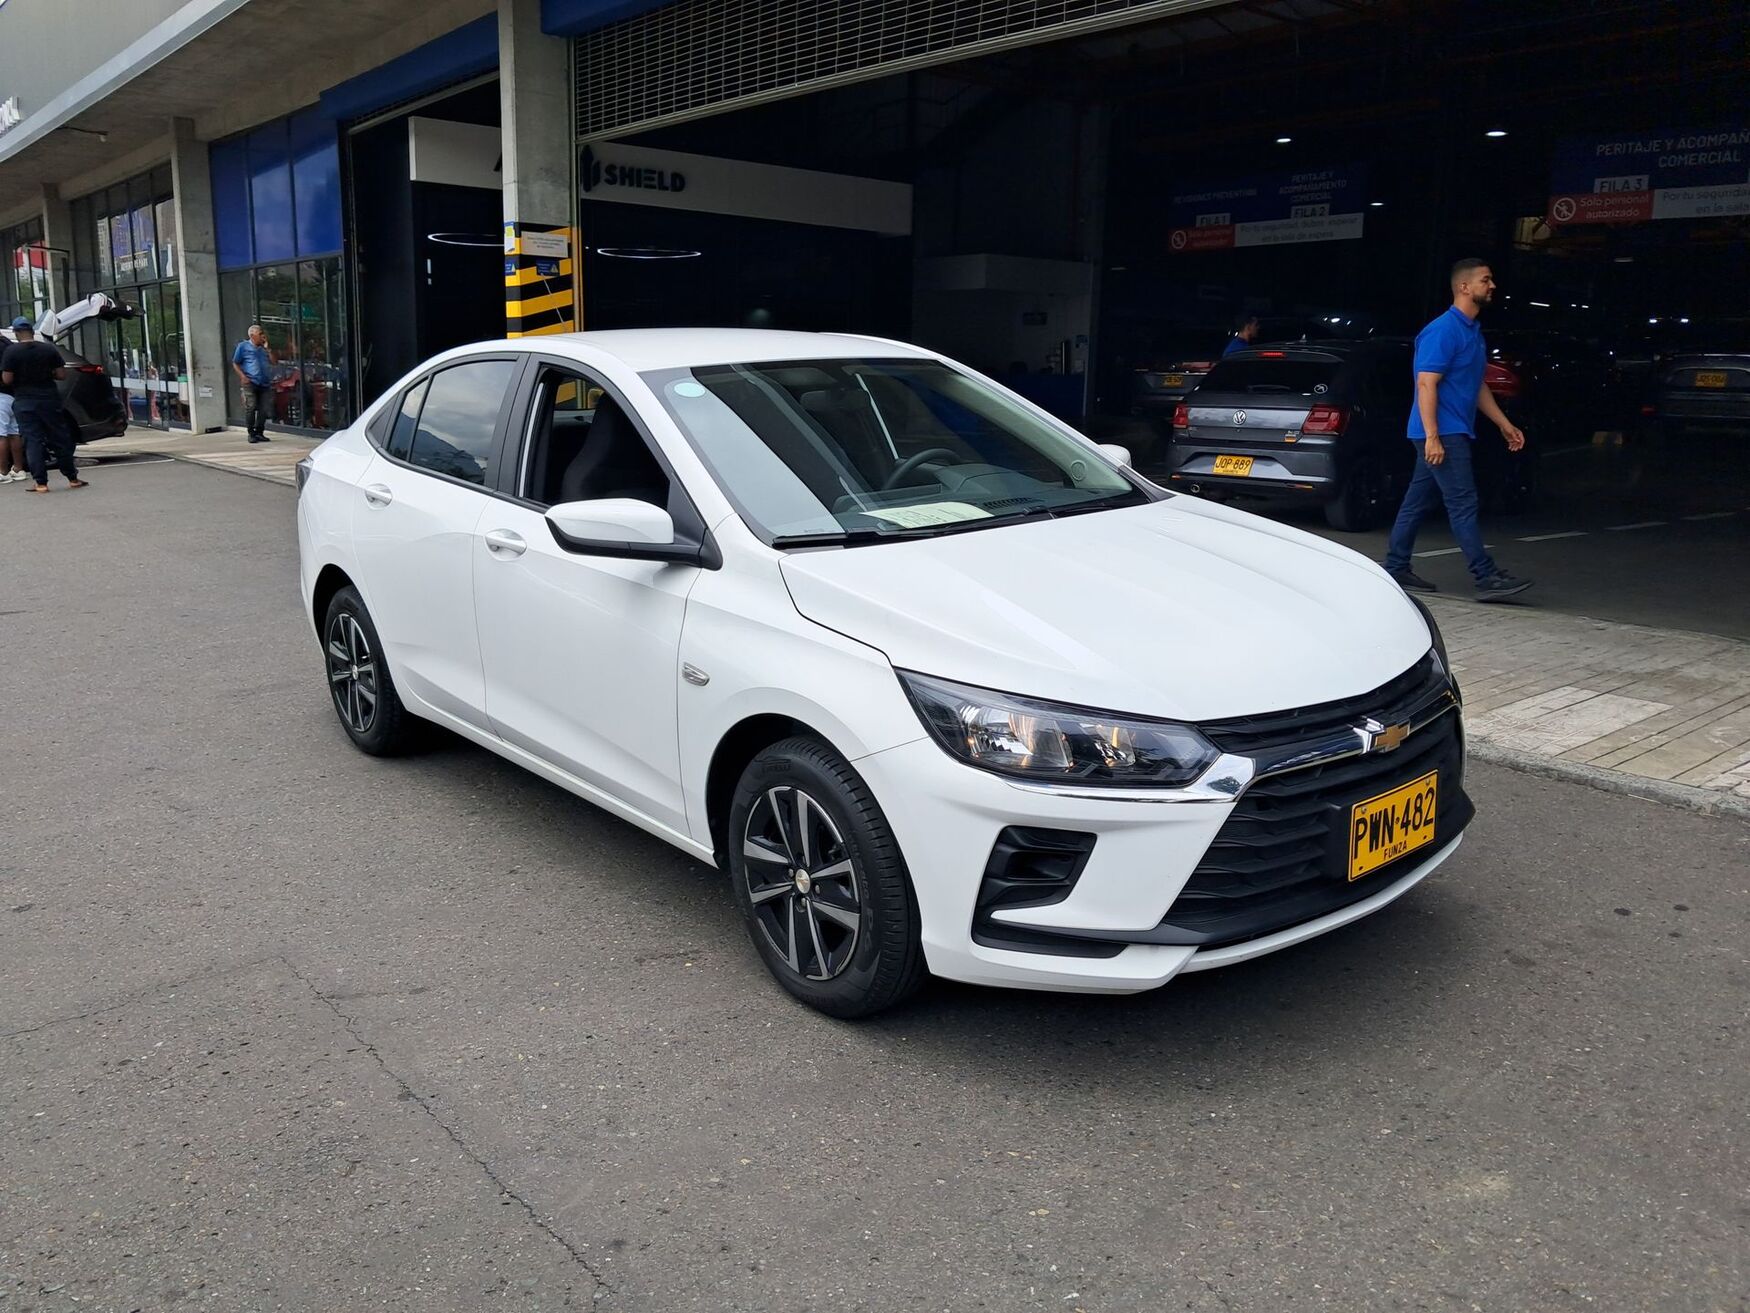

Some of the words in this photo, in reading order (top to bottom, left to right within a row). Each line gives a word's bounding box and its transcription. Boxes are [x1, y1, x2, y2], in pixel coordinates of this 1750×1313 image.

[1596, 139, 1662, 156] PERITAJE
[1664, 138, 1675, 151] Y
[1657, 149, 1742, 168] COMERCIAL
[604, 163, 686, 192] SHIELD
[1600, 180, 1630, 192] FILA
[1634, 178, 1642, 191] 3
[1294, 207, 1317, 219] FILA
[1319, 206, 1326, 217] 2
[1585, 207, 1640, 220] autorizado
[1383, 839, 1408, 861] FUNZA
